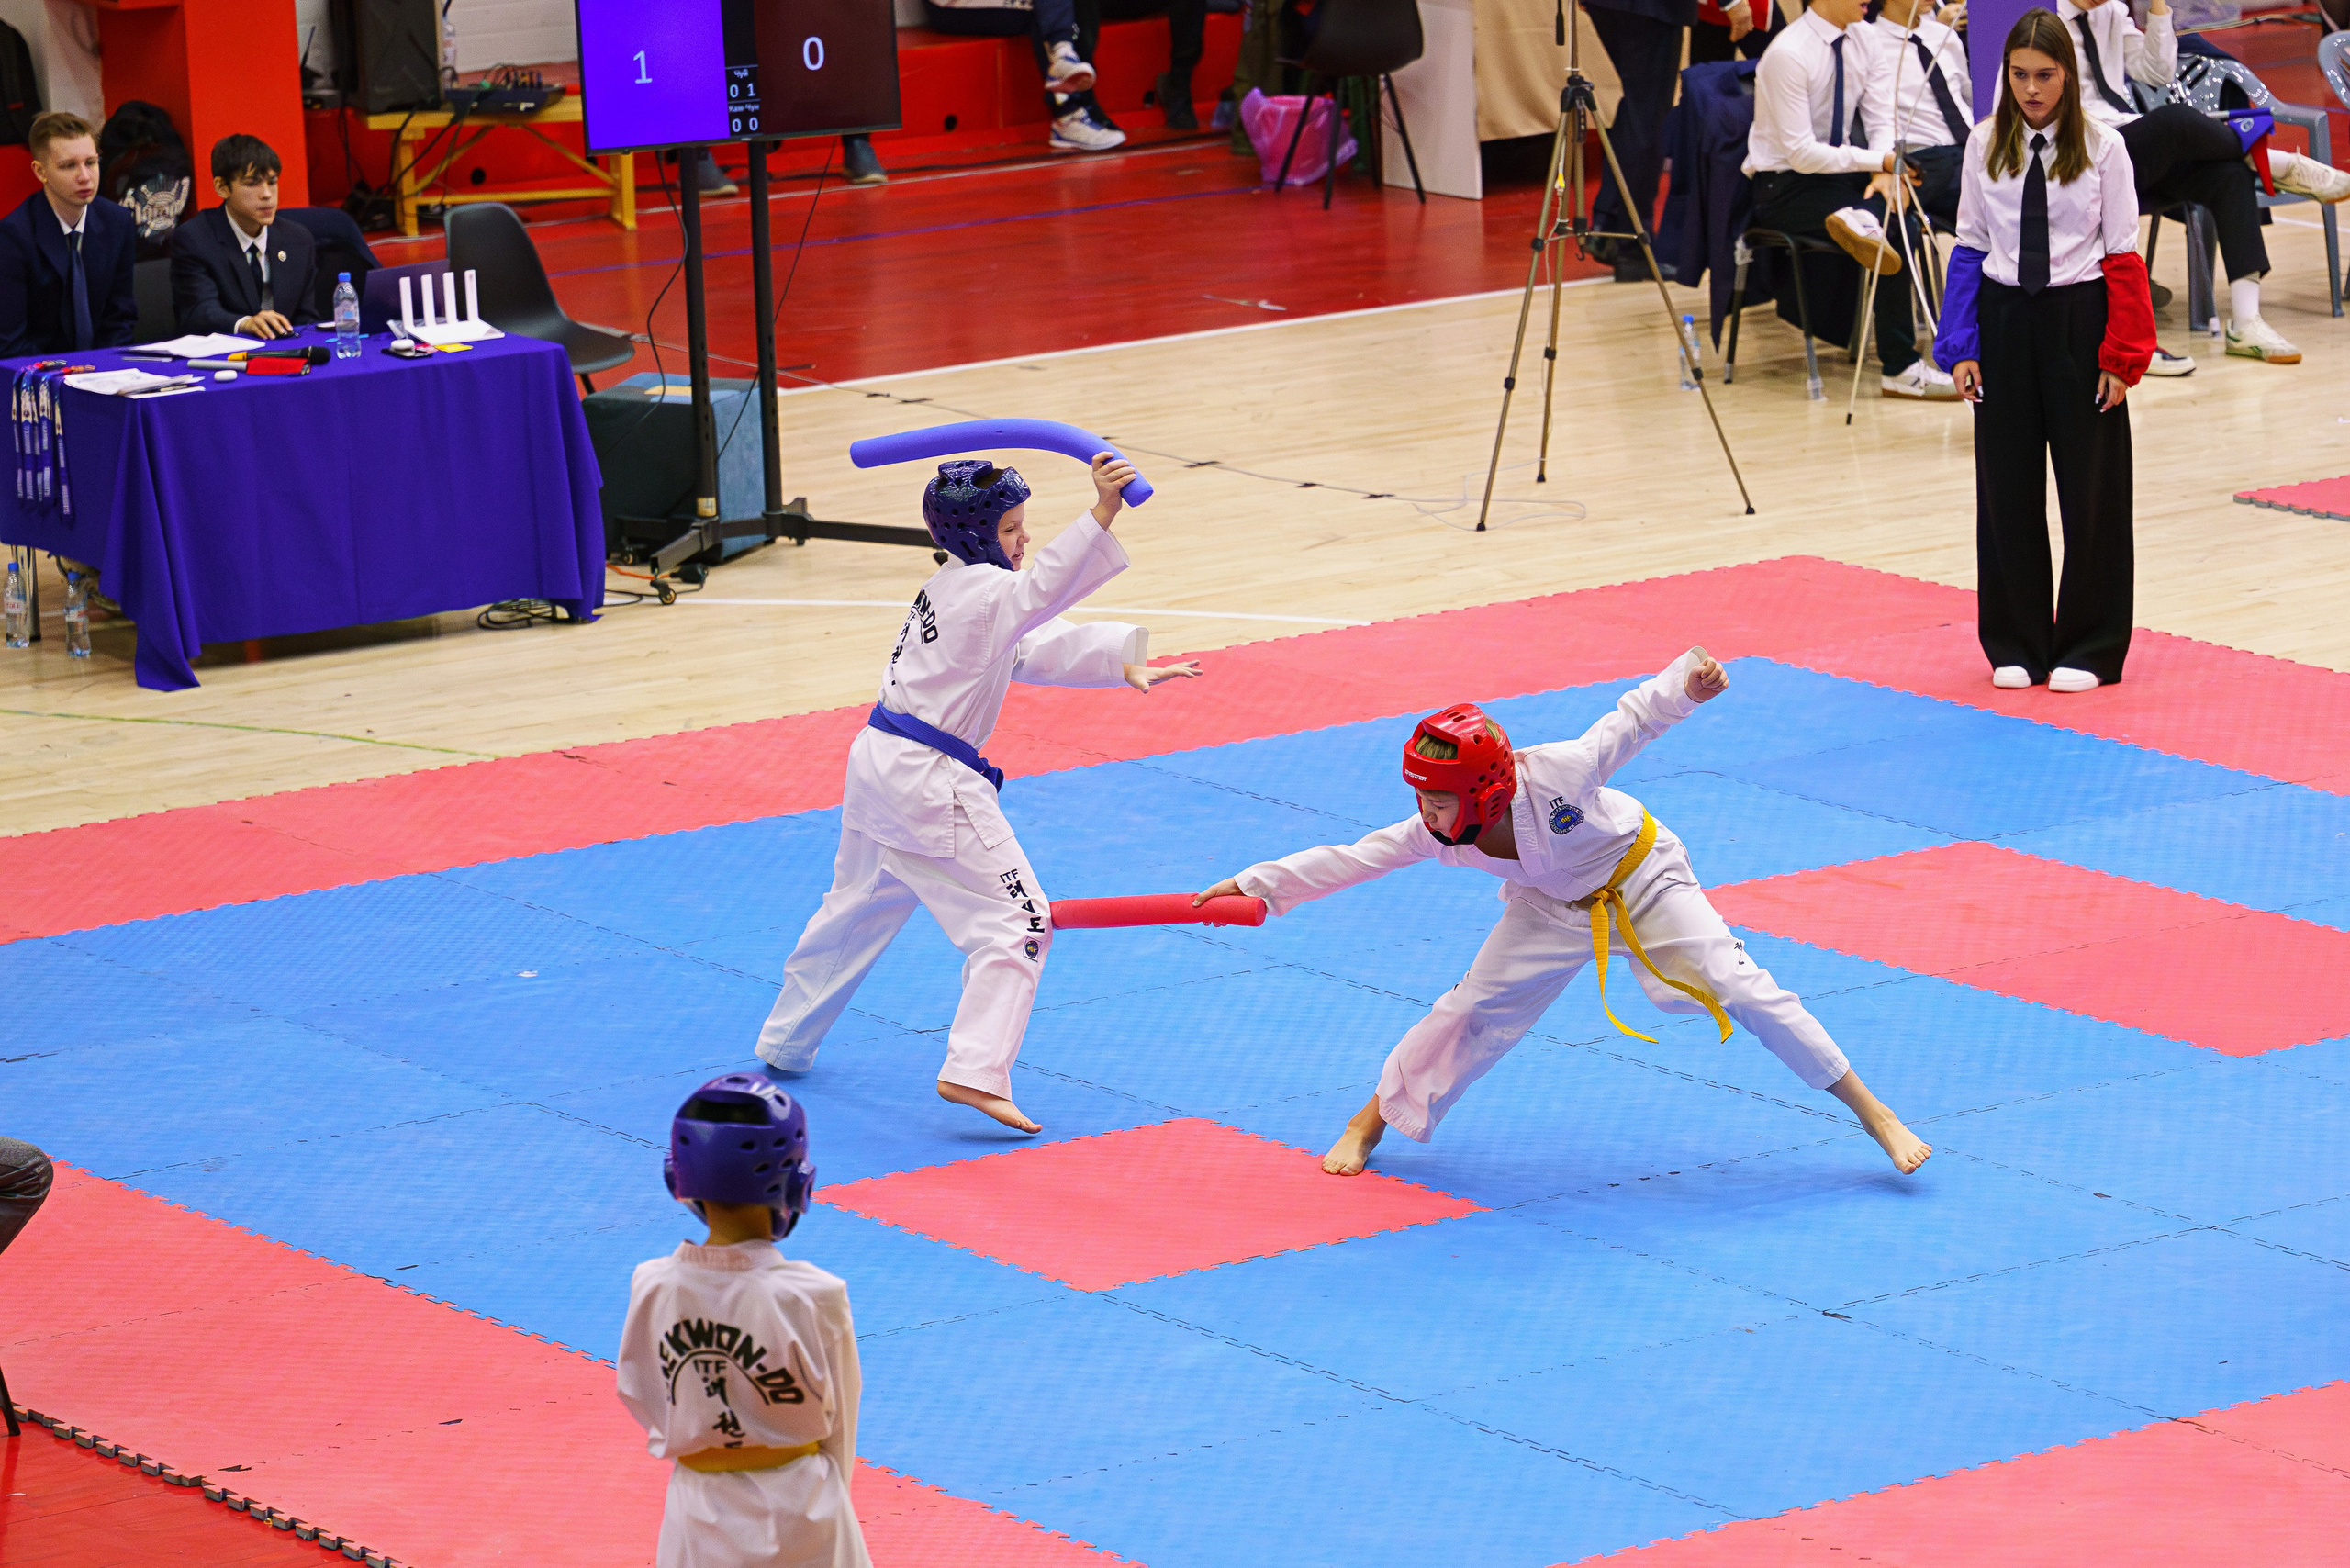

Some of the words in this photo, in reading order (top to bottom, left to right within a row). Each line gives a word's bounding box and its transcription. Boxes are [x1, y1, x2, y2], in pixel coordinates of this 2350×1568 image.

[802, 37, 825, 71] 0
[633, 50, 653, 84] 1
[730, 84, 739, 98] 0
[746, 82, 756, 97] 1
[732, 118, 742, 132] 0
[749, 117, 758, 131] 0
[1549, 796, 1564, 809] ITF
[1000, 868, 1019, 884] ITF
[693, 1359, 727, 1374] ITF
[701, 1376, 746, 1449] 태권
